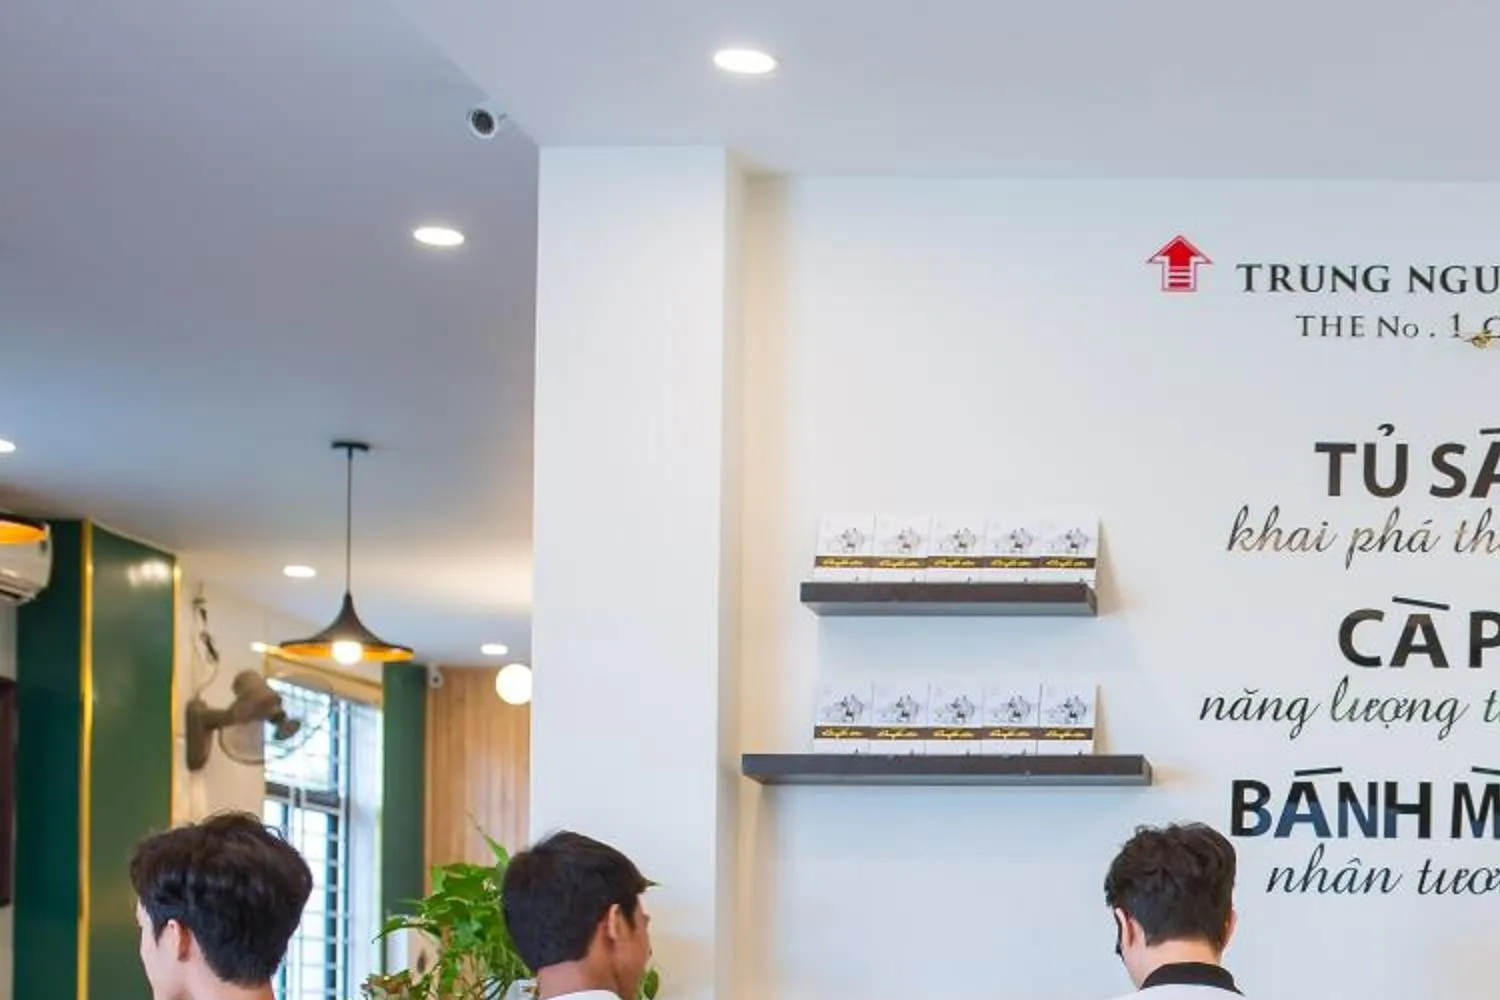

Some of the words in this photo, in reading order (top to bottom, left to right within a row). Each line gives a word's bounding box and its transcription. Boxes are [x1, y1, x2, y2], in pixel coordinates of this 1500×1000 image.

[1235, 263, 1391, 294] TRUNG
[1295, 314, 1366, 338] THE
[1314, 423, 1409, 498] TỦ
[1226, 504, 1338, 553] khai
[1344, 505, 1441, 571] phá
[1199, 687, 1322, 741] năng
[1329, 674, 1471, 742] lượng
[1265, 842, 1404, 895] nhân
